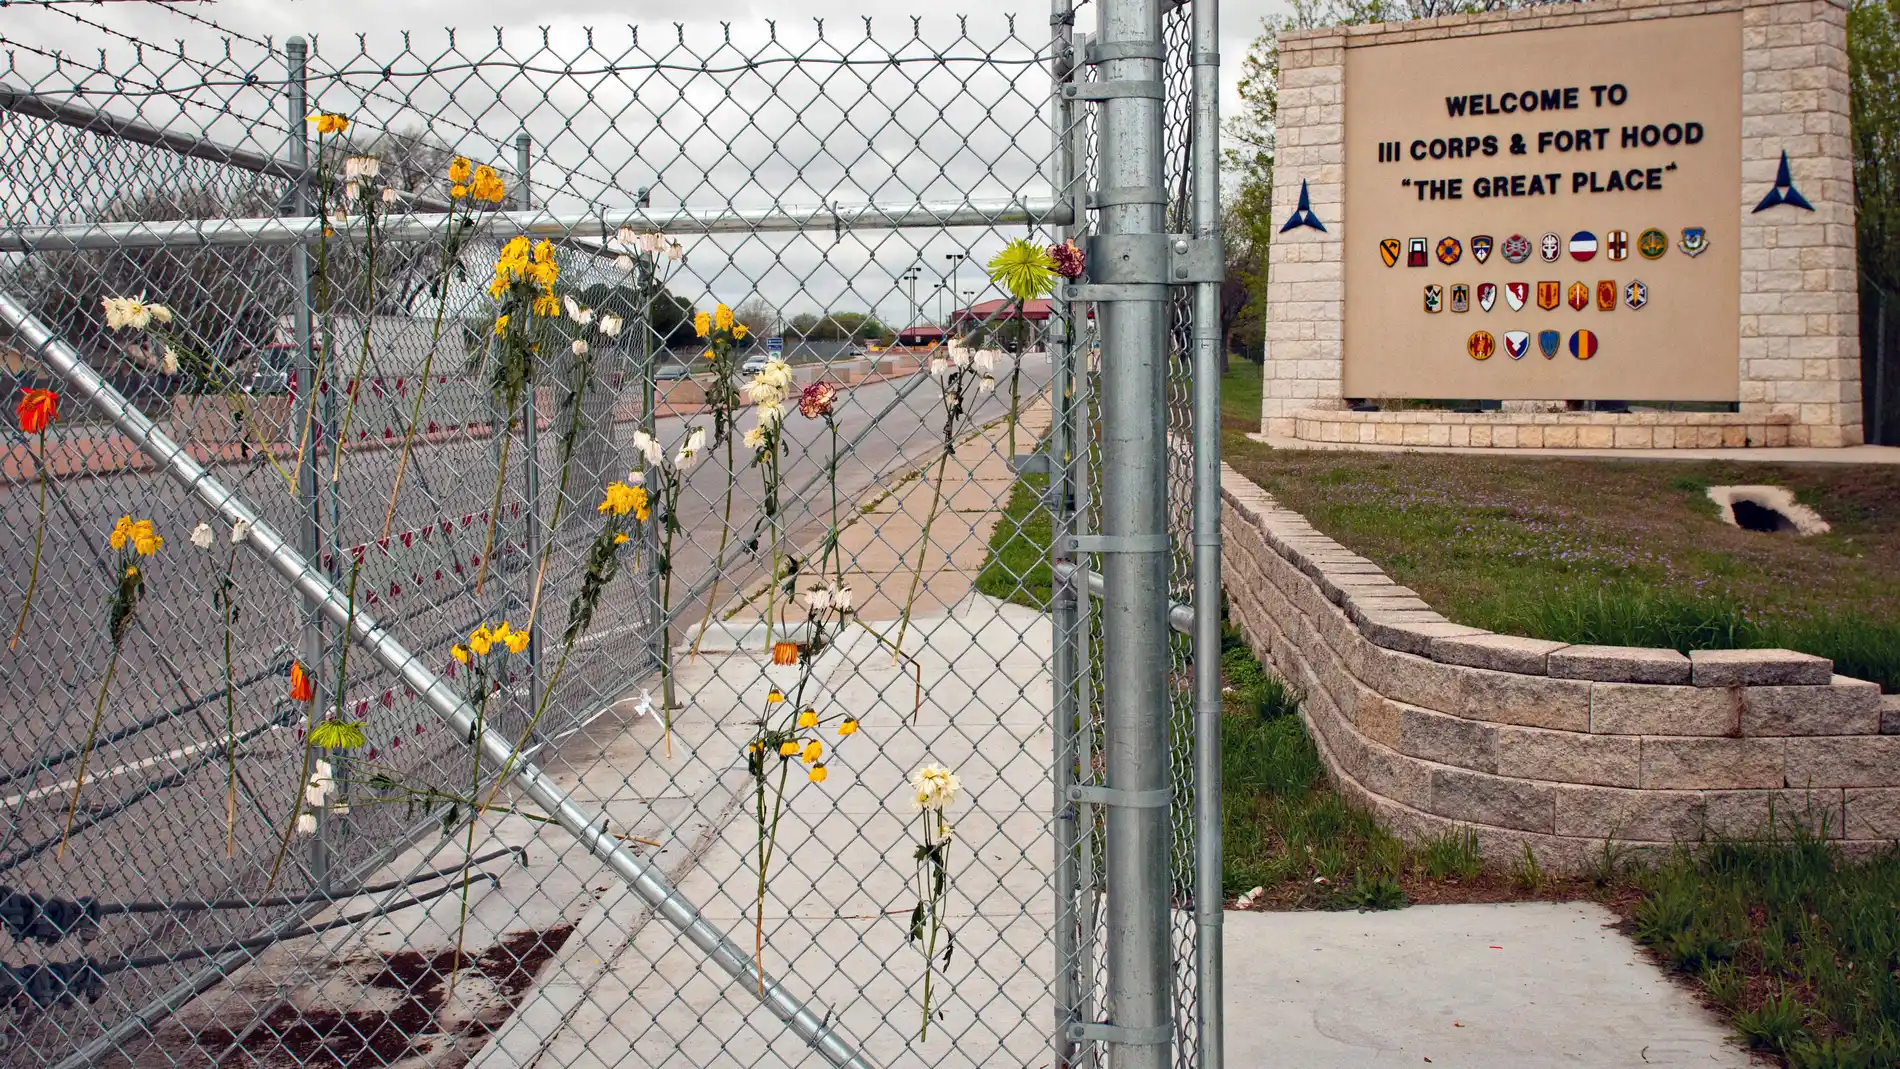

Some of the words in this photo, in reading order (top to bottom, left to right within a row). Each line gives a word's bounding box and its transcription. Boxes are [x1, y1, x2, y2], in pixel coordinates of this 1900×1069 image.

[1445, 86, 1580, 118] WELCOME
[1589, 83, 1629, 108] TO
[1377, 141, 1402, 165] III
[1409, 134, 1500, 162] CORPS
[1508, 132, 1528, 156] &
[1536, 127, 1611, 154] FORT
[1620, 121, 1706, 149] HOOD
[1472, 171, 1562, 199] GREAT
